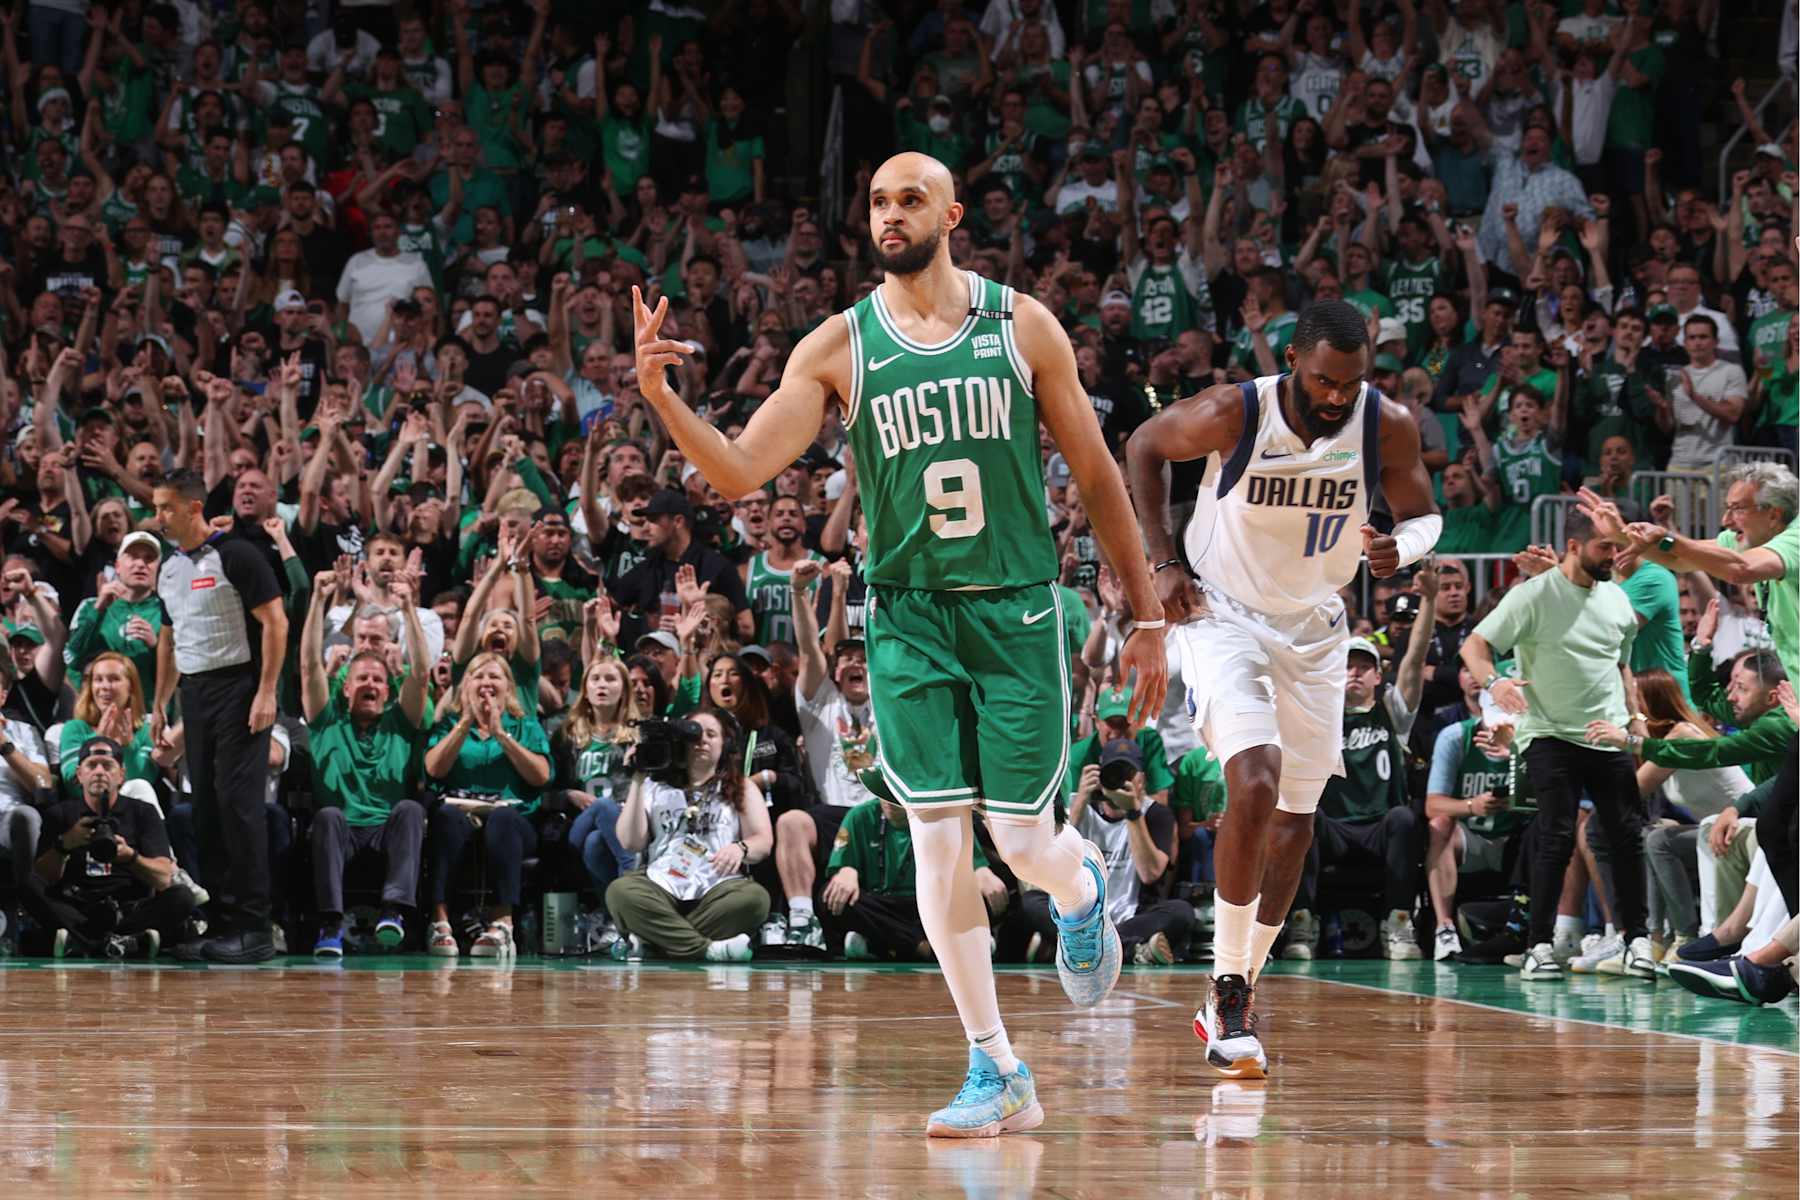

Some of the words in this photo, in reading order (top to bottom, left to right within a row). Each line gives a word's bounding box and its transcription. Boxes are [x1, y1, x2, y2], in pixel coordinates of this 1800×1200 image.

[291, 116, 311, 142] 7
[976, 309, 1006, 320] WALTON
[1139, 296, 1174, 326] 42
[971, 333, 1002, 350] VISTA
[973, 346, 1003, 361] PRINT
[870, 376, 1012, 459] BOSTON
[1323, 450, 1357, 462] chime
[923, 458, 986, 540] 9
[1246, 476, 1358, 511] DALLAS
[1303, 512, 1350, 558] 10
[1376, 750, 1391, 781] 0
